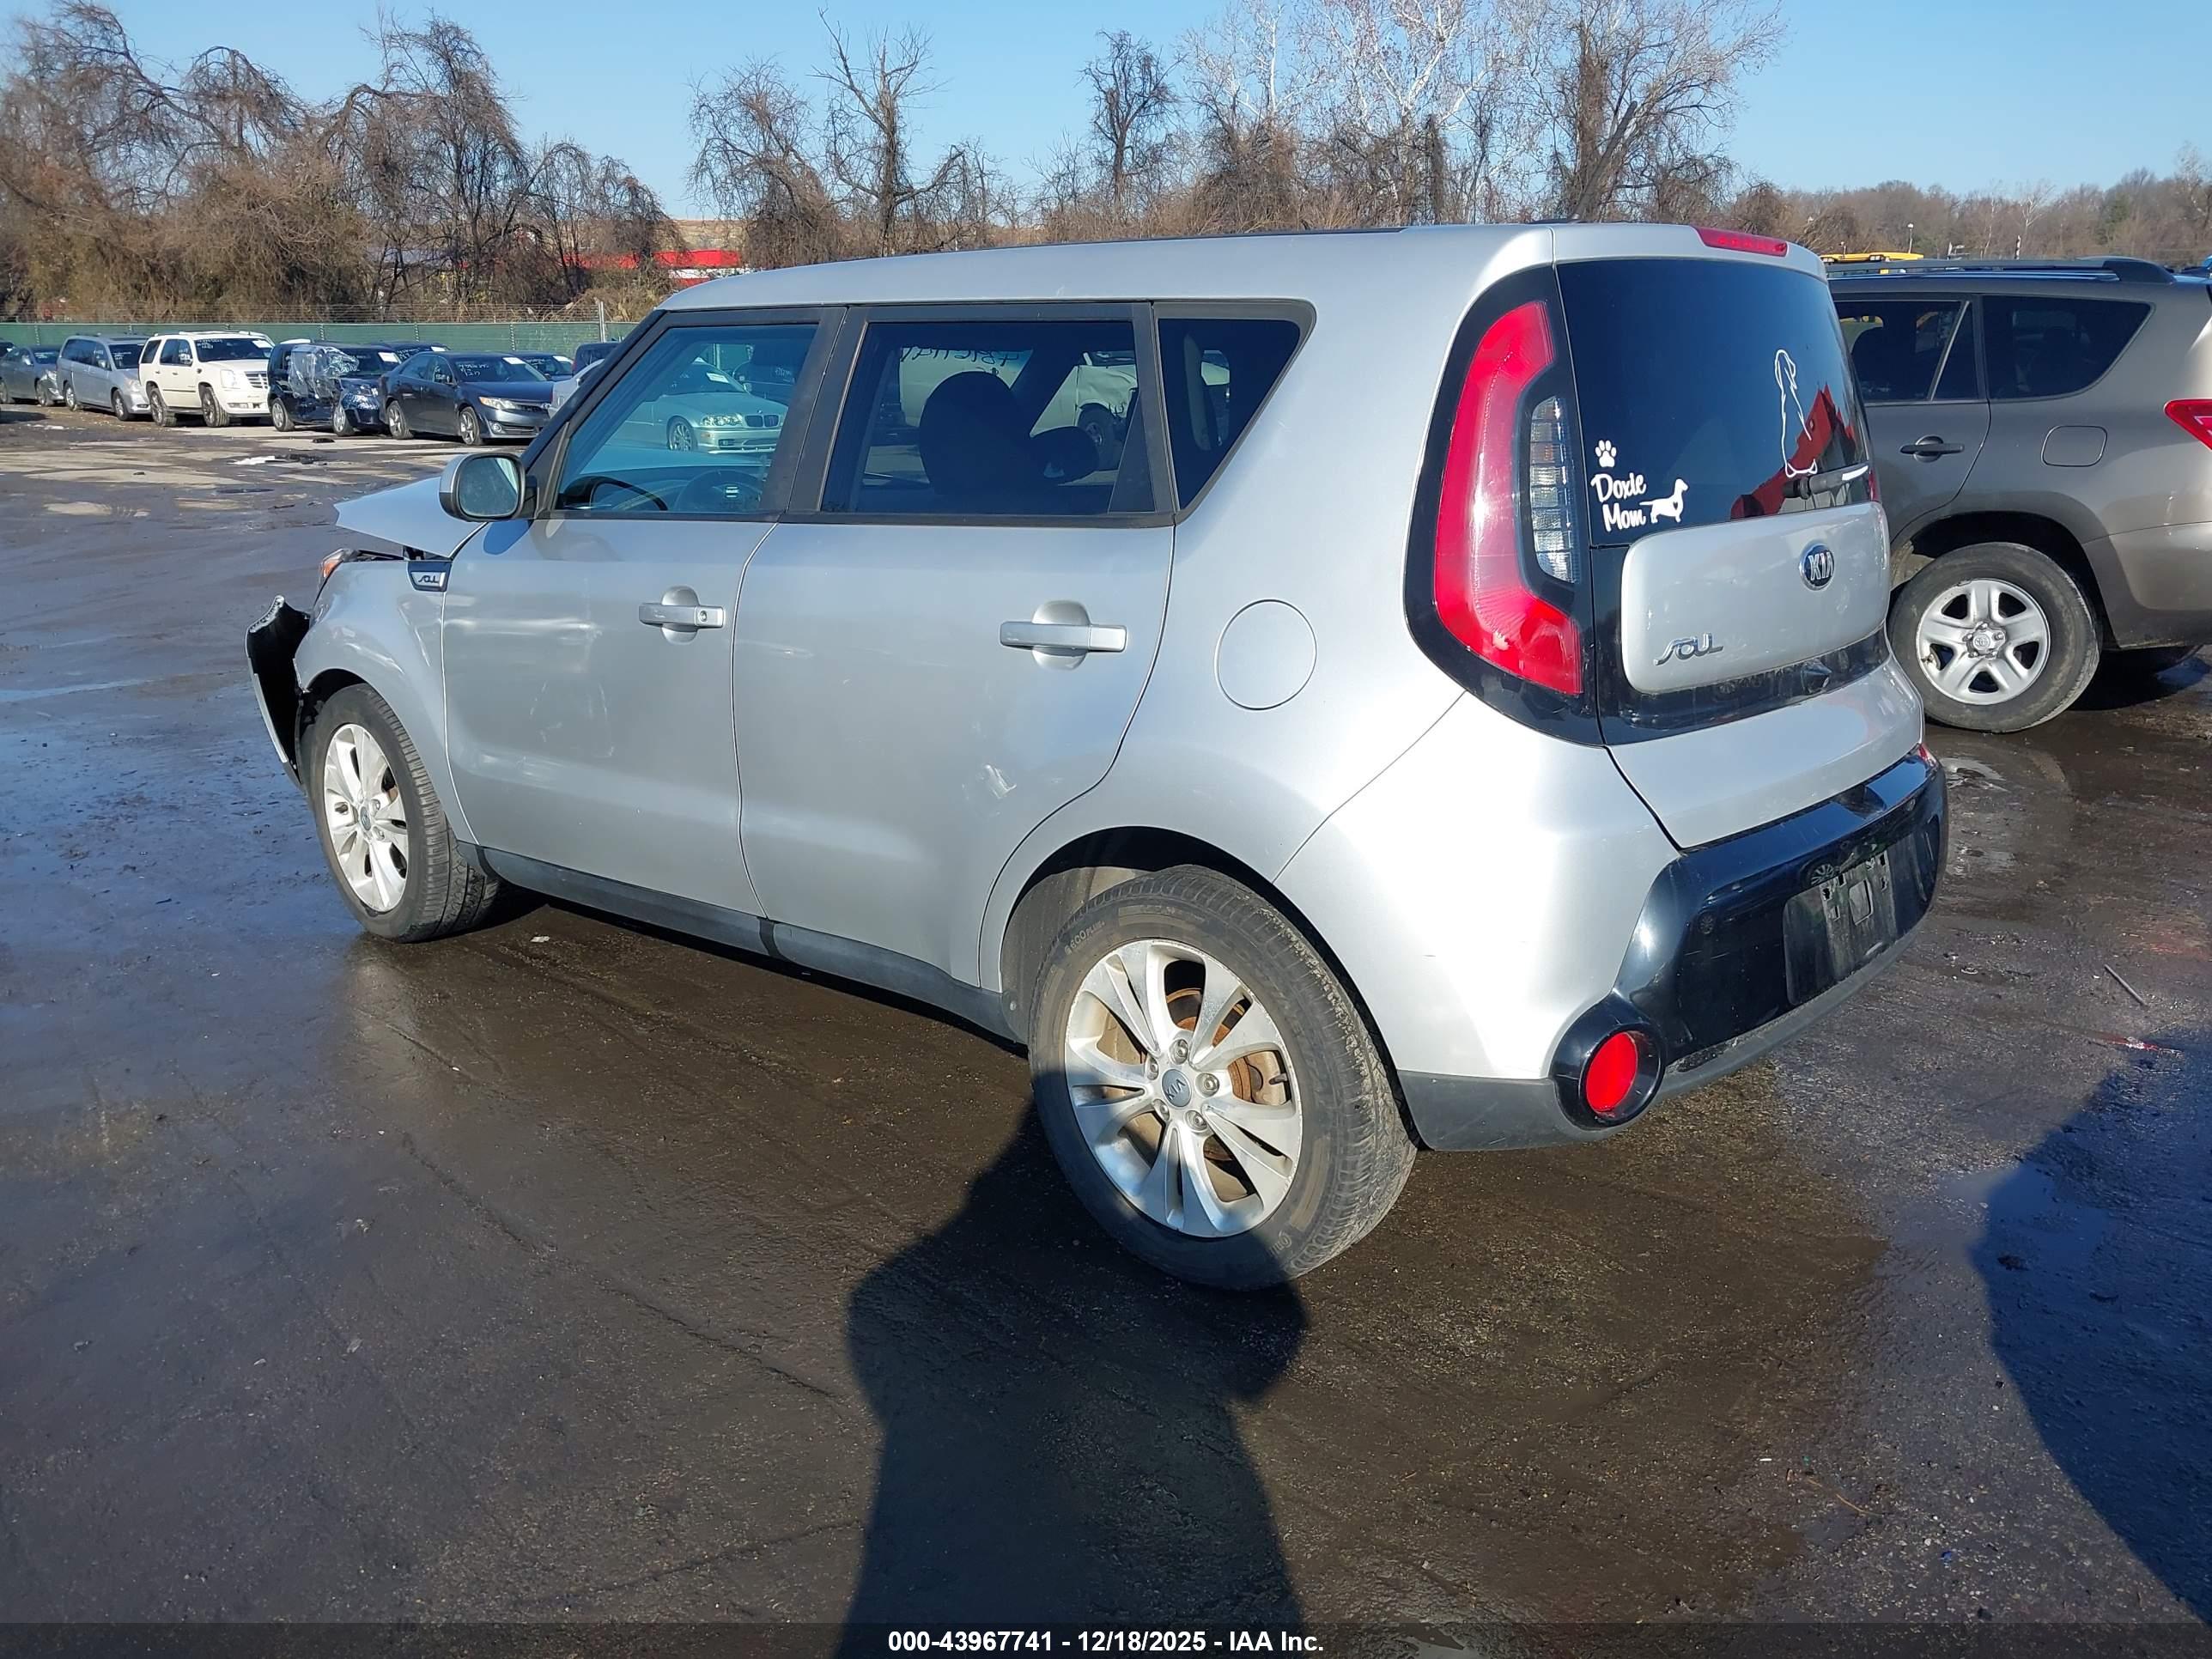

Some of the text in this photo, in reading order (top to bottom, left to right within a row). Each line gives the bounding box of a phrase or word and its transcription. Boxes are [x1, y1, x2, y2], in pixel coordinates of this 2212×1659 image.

[1590, 472, 1647, 502] Doxie
[1602, 502, 1647, 532] Mom
[1808, 551, 1833, 580] KIA
[1164, 1079, 1186, 1101] KIA
